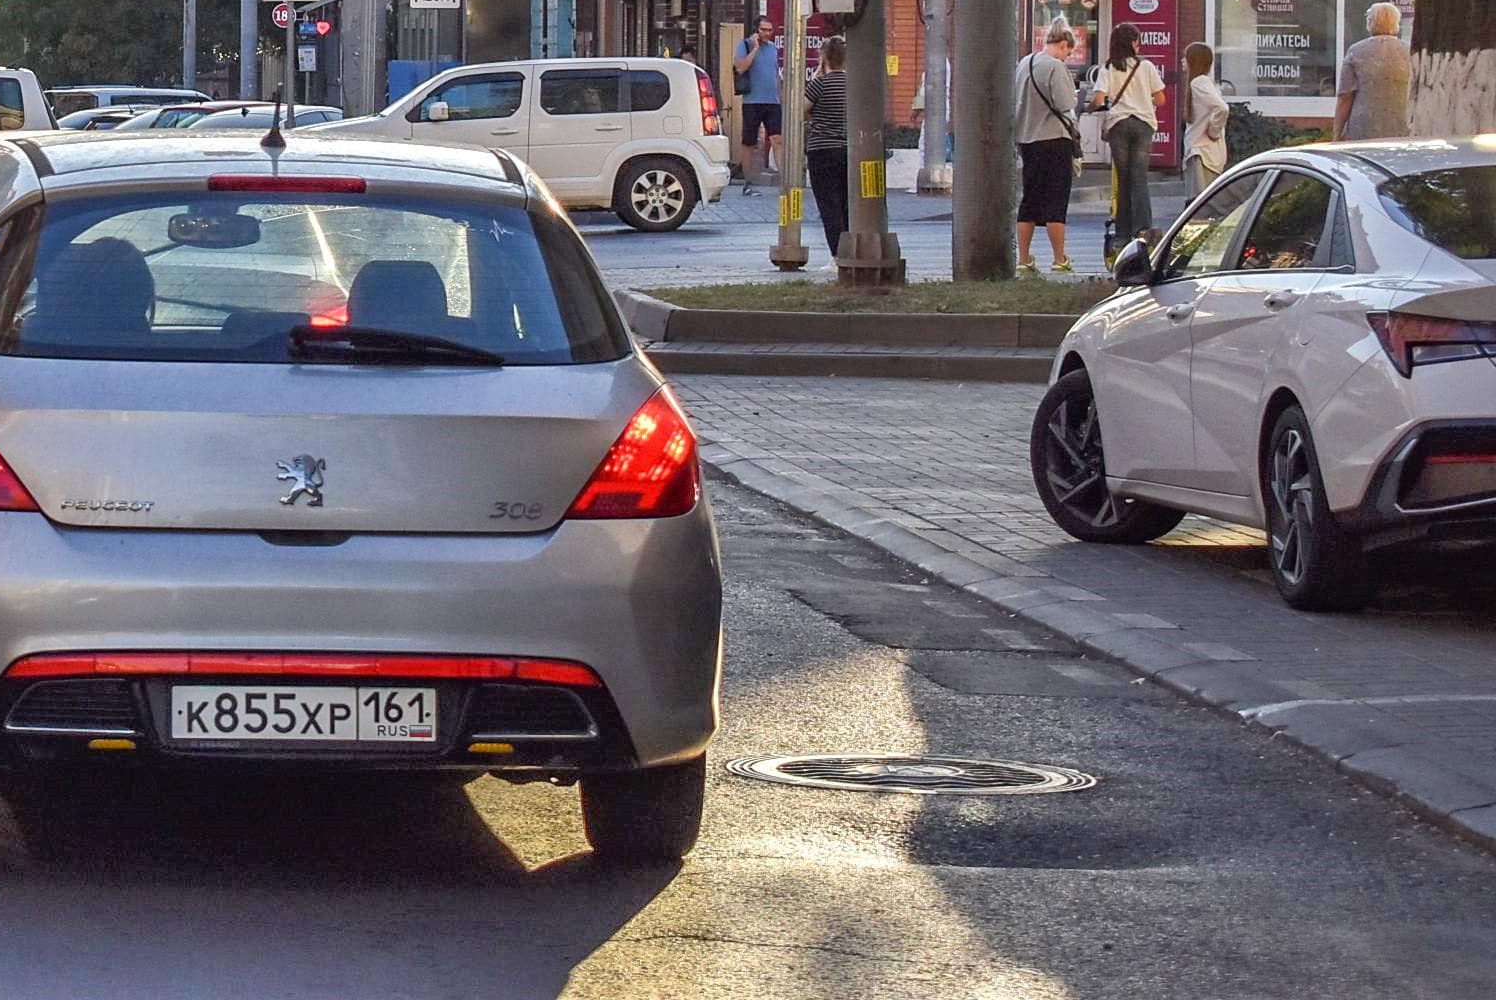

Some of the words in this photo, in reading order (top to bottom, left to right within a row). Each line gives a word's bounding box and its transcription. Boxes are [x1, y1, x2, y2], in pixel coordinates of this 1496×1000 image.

[1255, 34, 1310, 48] ЛИКАТЕСЫ
[60, 500, 155, 512] PEUGEOT
[488, 501, 543, 520] 308
[186, 692, 352, 735] К855ХР
[363, 691, 424, 724] 161
[377, 725, 408, 737] RUS
